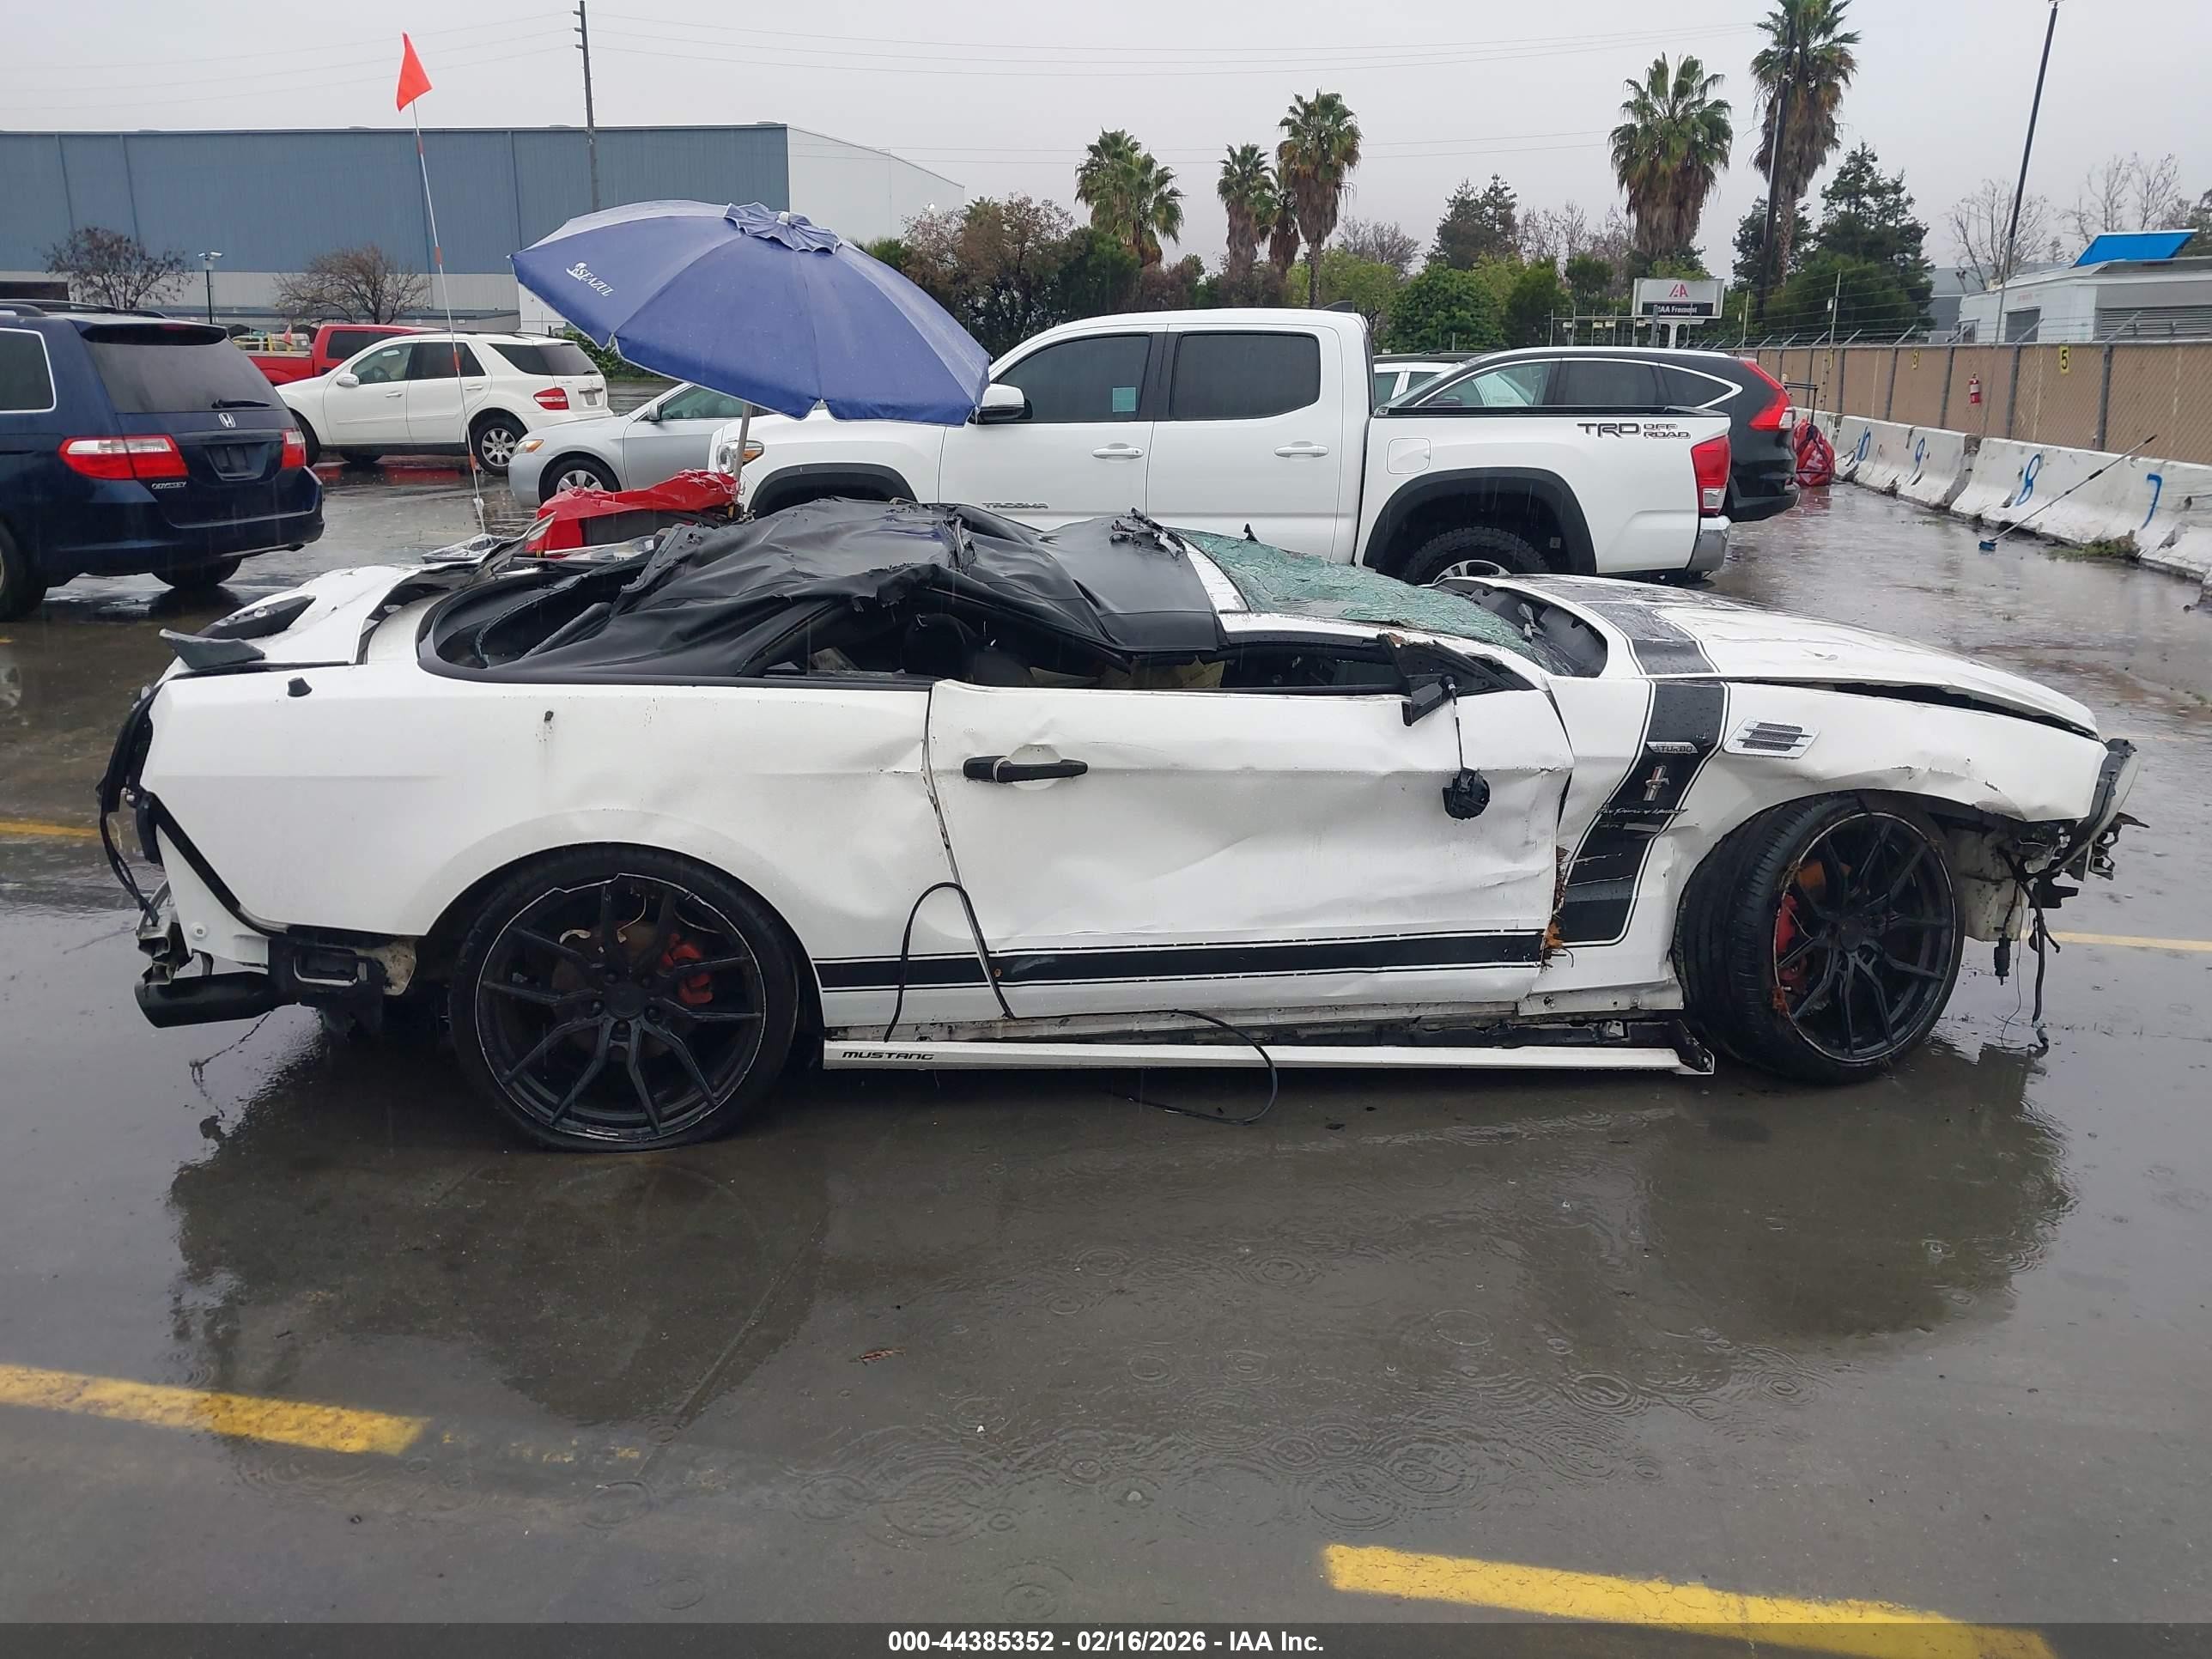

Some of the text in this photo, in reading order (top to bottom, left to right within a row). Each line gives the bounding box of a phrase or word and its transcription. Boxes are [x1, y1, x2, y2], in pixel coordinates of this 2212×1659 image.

[576, 266, 615, 297] SEAZUL
[1671, 305, 1698, 314] Fremont
[2061, 349, 2069, 370] 5
[1576, 422, 1642, 439] TRD
[1643, 422, 1679, 431] OFF
[1643, 431, 1692, 440] ROAD
[1905, 435, 1925, 483] 9
[151, 481, 187, 489] ODYSSEY
[2014, 453, 2041, 507] 8
[2140, 473, 2163, 532] 7
[842, 1051, 935, 1060] MUSTANG
